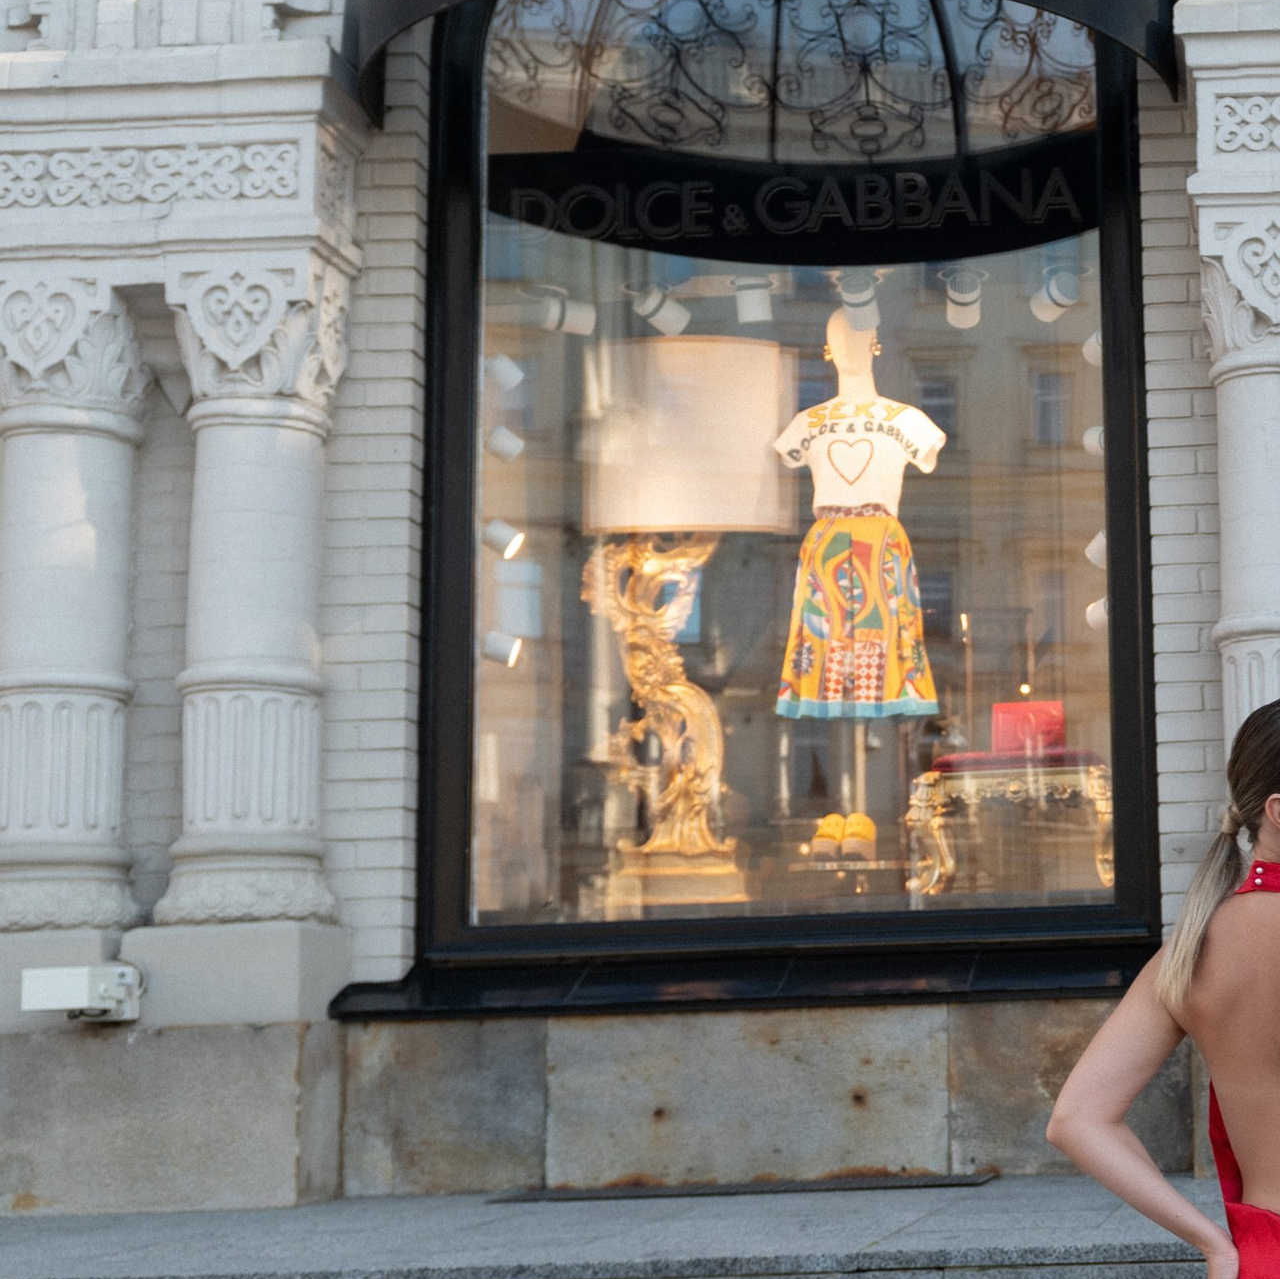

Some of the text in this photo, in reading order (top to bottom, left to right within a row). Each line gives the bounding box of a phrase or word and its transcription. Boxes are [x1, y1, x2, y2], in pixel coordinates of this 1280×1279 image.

[510, 167, 1083, 243] DOLCE & GABBANA
[807, 401, 910, 428] SEXY
[787, 423, 839, 462] DOLCE
[846, 423, 856, 433] &
